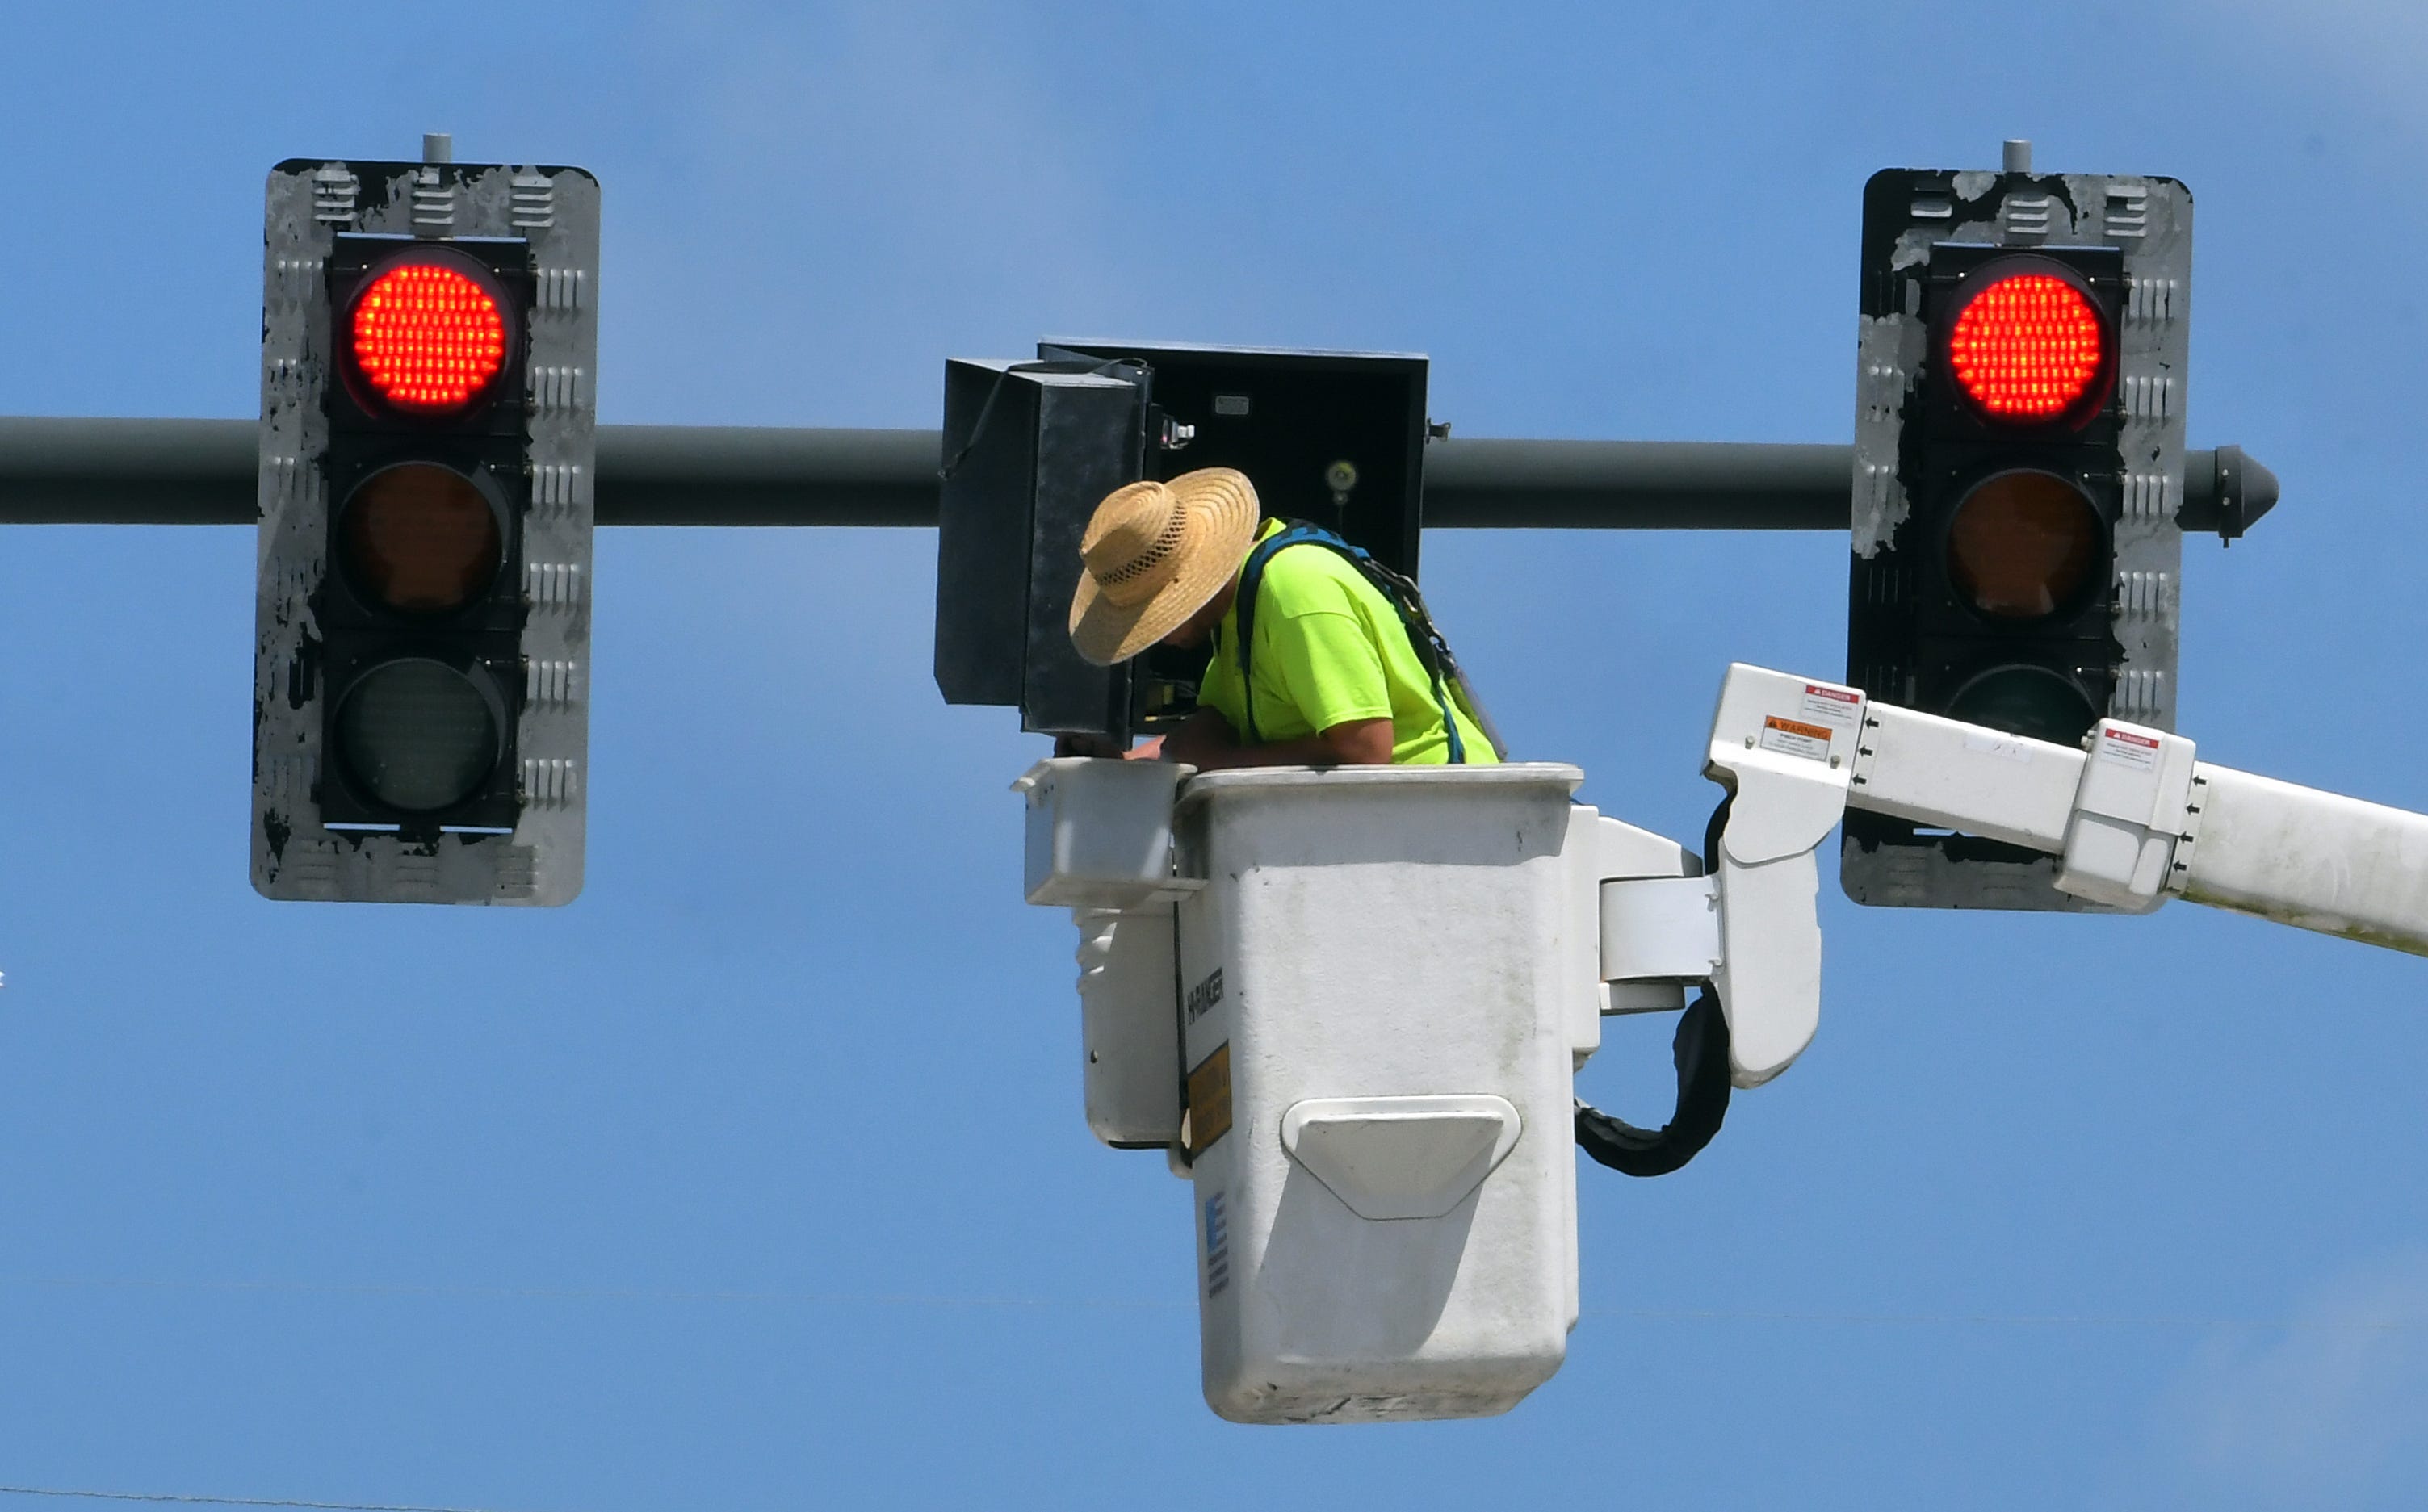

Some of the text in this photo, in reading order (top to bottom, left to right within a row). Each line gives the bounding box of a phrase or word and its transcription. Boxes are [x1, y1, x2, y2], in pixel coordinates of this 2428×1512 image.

[1822, 689, 1851, 701] DANGER
[1781, 722, 1829, 739] WARNING
[2120, 734, 2150, 746] DANGER
